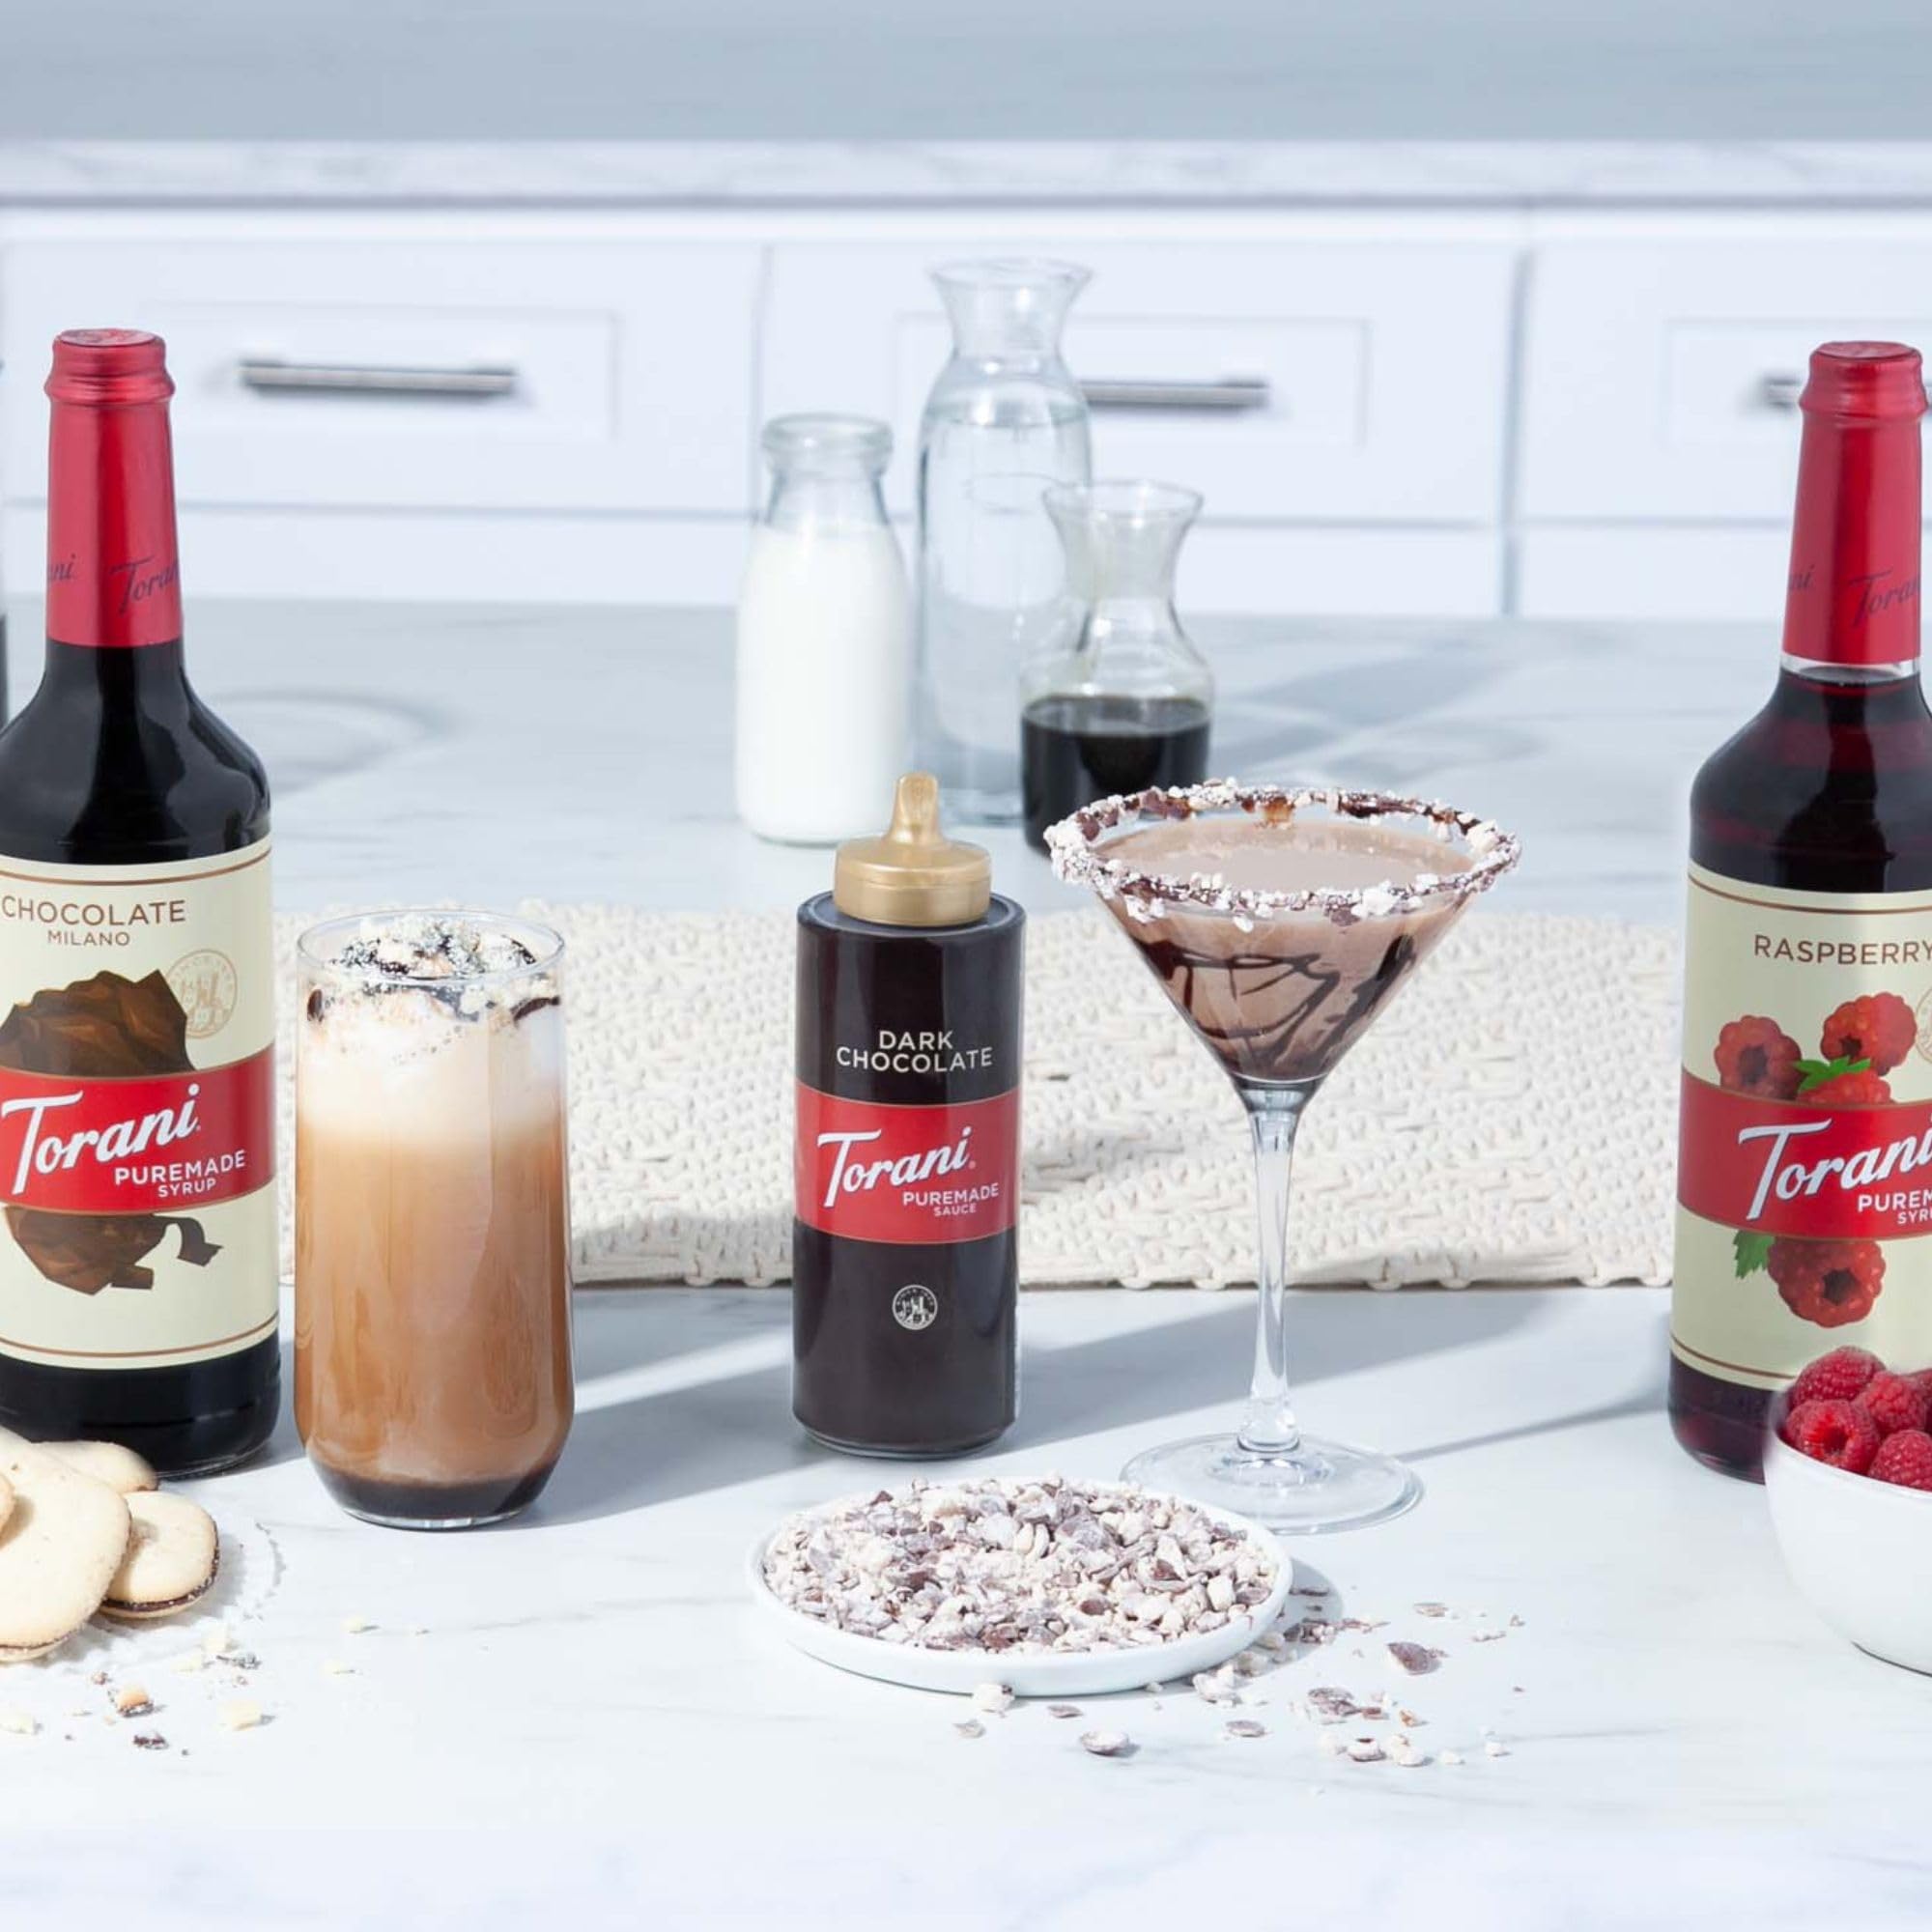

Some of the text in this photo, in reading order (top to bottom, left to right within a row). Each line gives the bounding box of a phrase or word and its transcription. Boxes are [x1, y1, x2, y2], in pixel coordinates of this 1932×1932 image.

[2, 895, 185, 926] CHOCOLATE
[48, 930, 130, 947] MILANO
[1754, 934, 1932, 964] RASPBERRY
[880, 1031, 953, 1051] DARK
[837, 1047, 993, 1072] CHOCOLATE
[1, 1083, 200, 1195] Torani
[114, 1150, 246, 1185] PUREMADE
[817, 1126, 972, 1208] Torani
[158, 1179, 217, 1198] SYRUP
[903, 1182, 1000, 1207] PUREMADE
[933, 1203, 977, 1217] SAUCE
[1896, 1208, 1932, 1225] SYR
